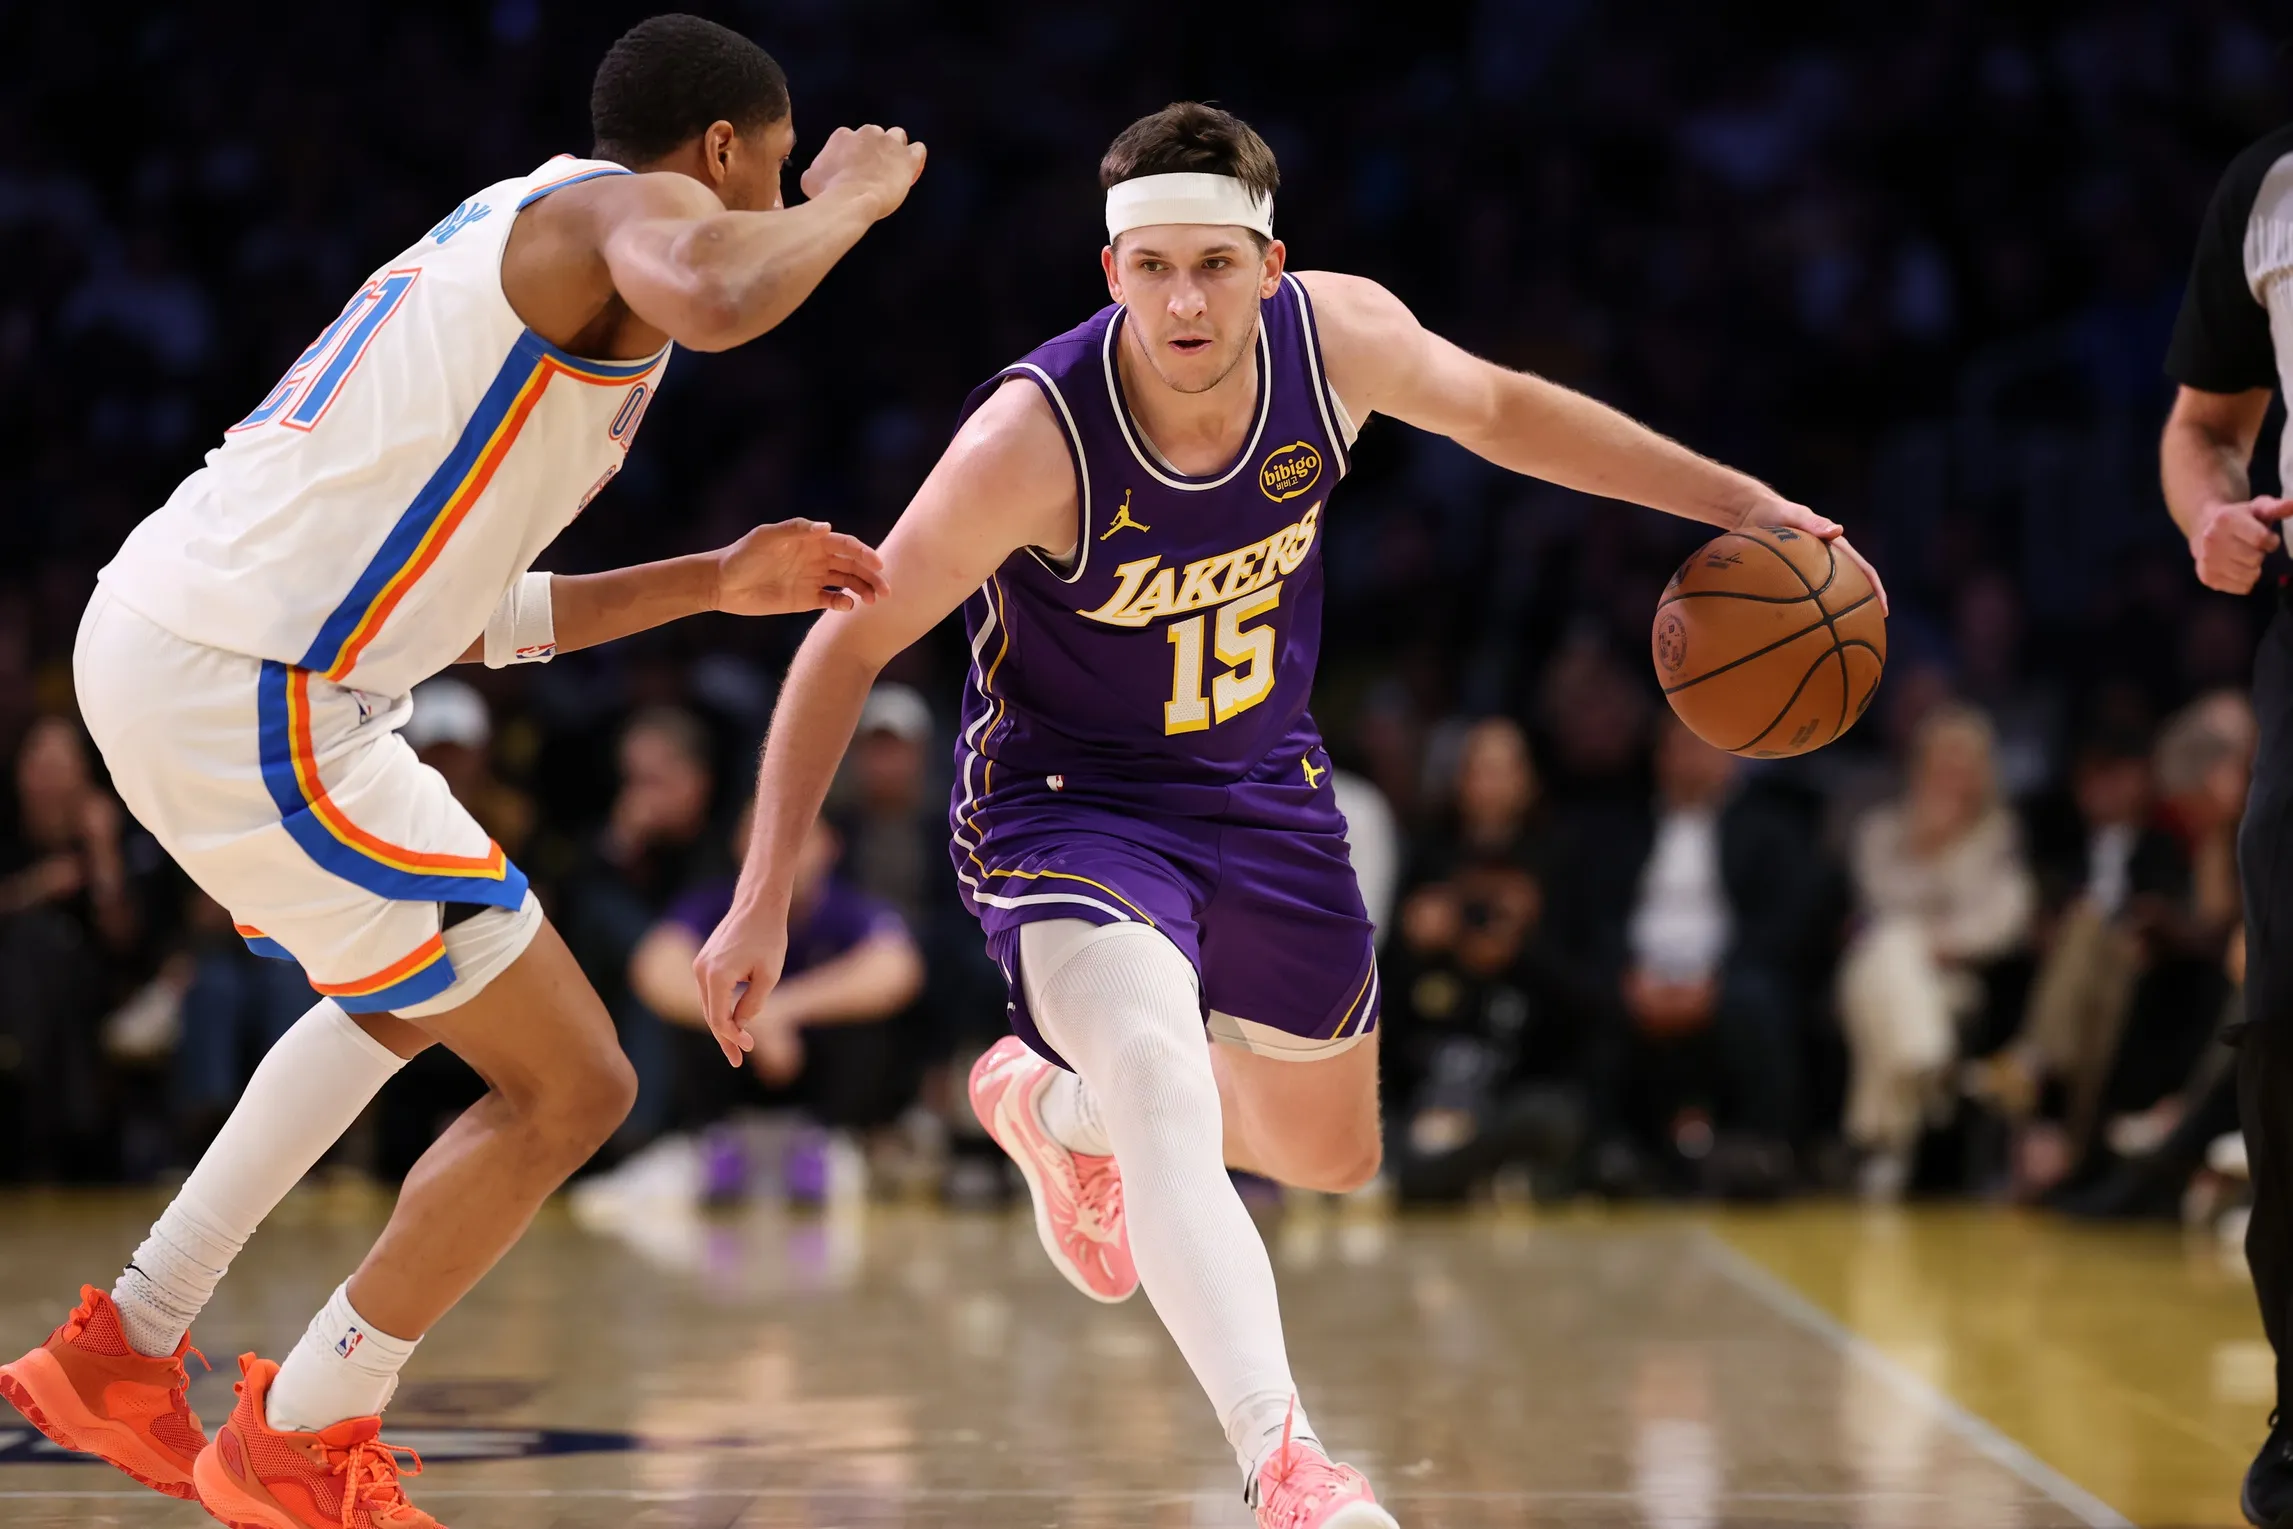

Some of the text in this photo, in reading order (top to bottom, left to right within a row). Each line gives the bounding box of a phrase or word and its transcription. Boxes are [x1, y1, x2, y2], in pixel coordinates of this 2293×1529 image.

[1263, 455, 1317, 487] bibigo
[1275, 475, 1299, 491] 비비고
[1075, 500, 1322, 627] LAKERS
[1164, 580, 1284, 736] 15
